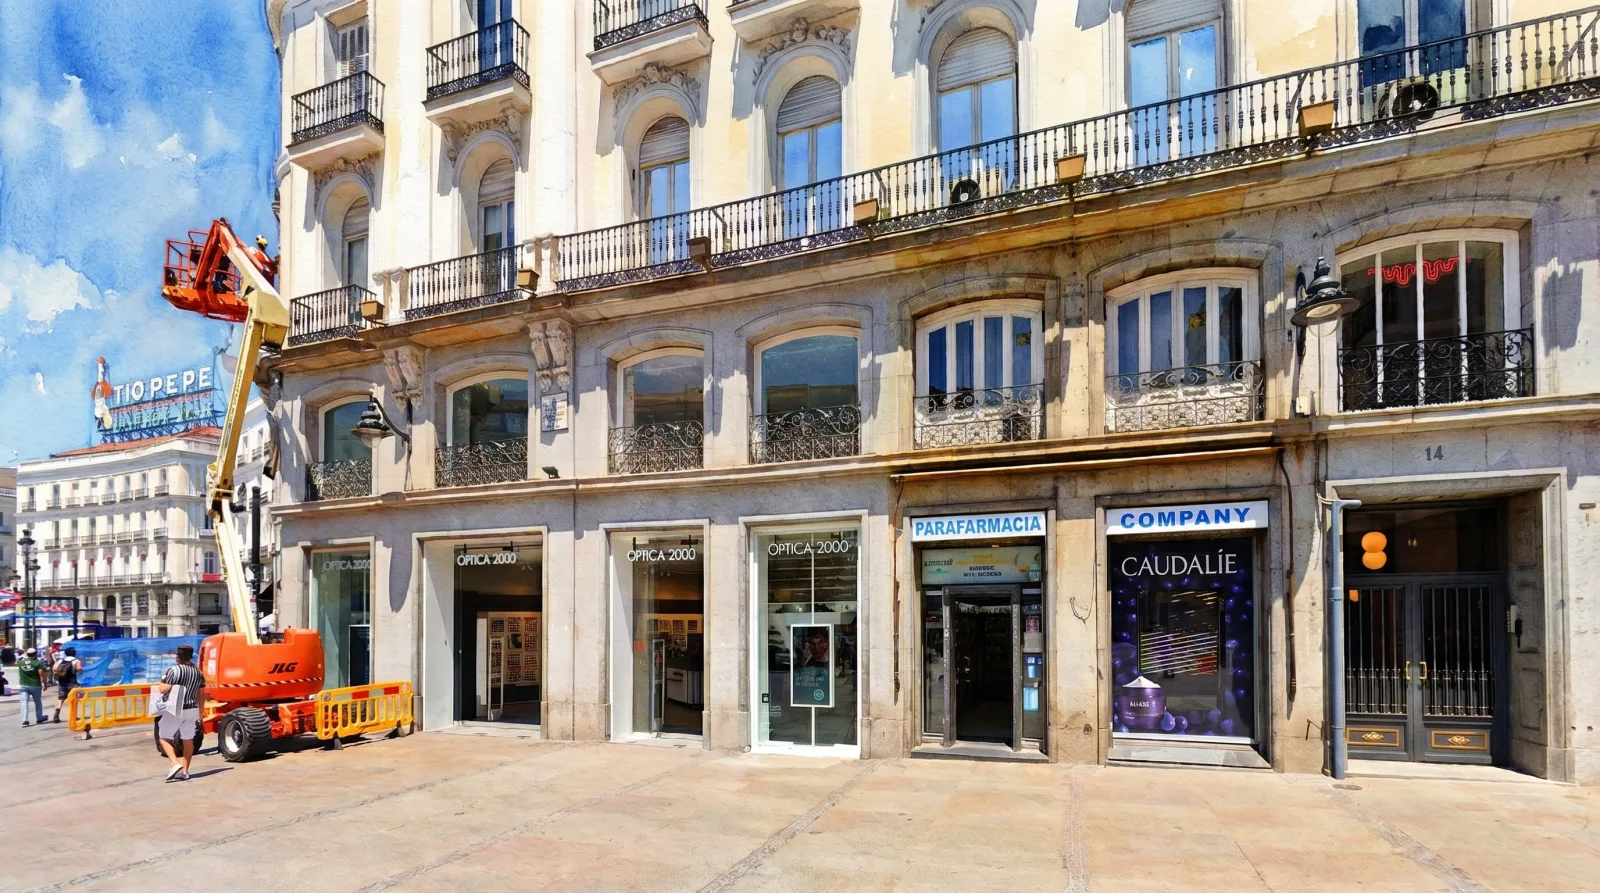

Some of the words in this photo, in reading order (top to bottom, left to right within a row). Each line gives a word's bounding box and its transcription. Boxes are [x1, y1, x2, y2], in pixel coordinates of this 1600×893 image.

[113, 381, 144, 404] TIO
[150, 366, 211, 398] PEPE
[1425, 445, 1444, 461] 14
[1120, 507, 1251, 529] COMPANY
[915, 516, 1041, 537] PARAFARMACIA
[627, 549, 666, 562] OPTICA
[668, 548, 696, 561] 2000
[768, 542, 812, 555] OPTICA
[816, 540, 849, 554] 2000
[323, 560, 352, 571] OPTICA
[457, 554, 490, 566] OPTICA
[493, 553, 517, 565] 2000
[1121, 548, 1238, 577] CAUDALÍE
[268, 662, 298, 675] JLG
